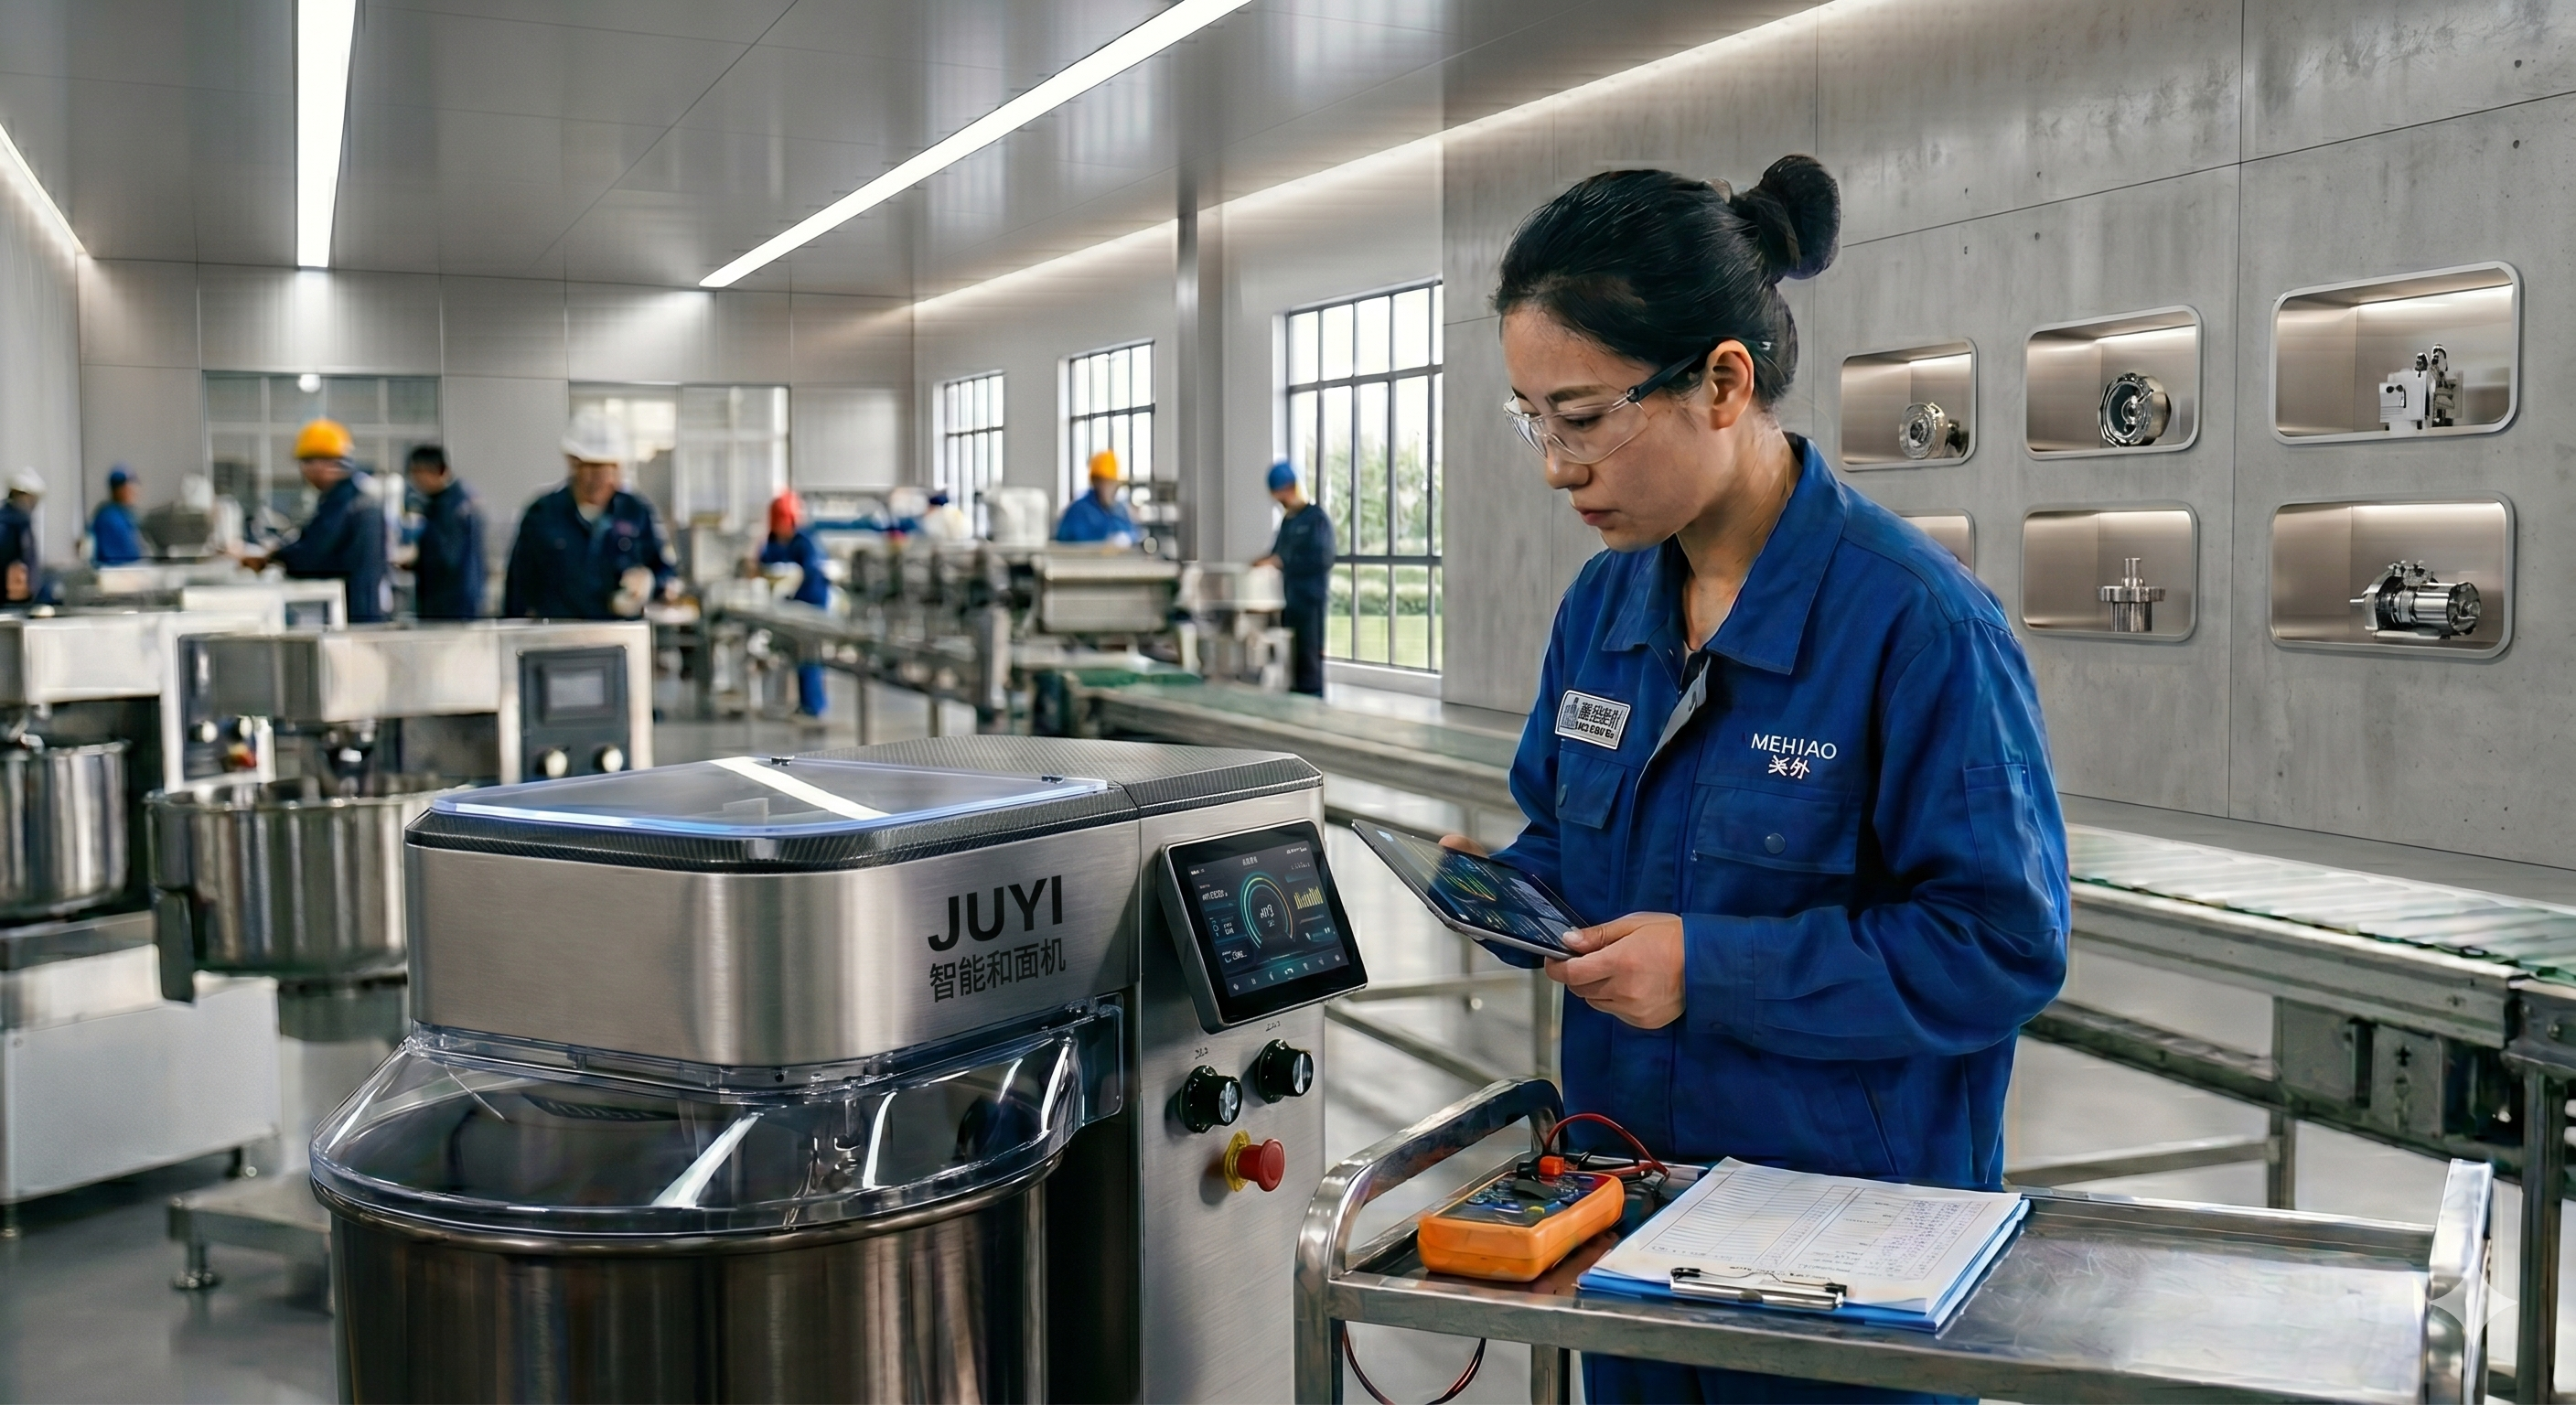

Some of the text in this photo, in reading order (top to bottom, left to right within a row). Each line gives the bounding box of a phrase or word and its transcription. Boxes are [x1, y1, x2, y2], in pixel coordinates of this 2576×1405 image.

[1751, 733, 1837, 759] MEHIAO
[928, 874, 1063, 952] JUYI
[929, 937, 1067, 1003] 智能和面机
